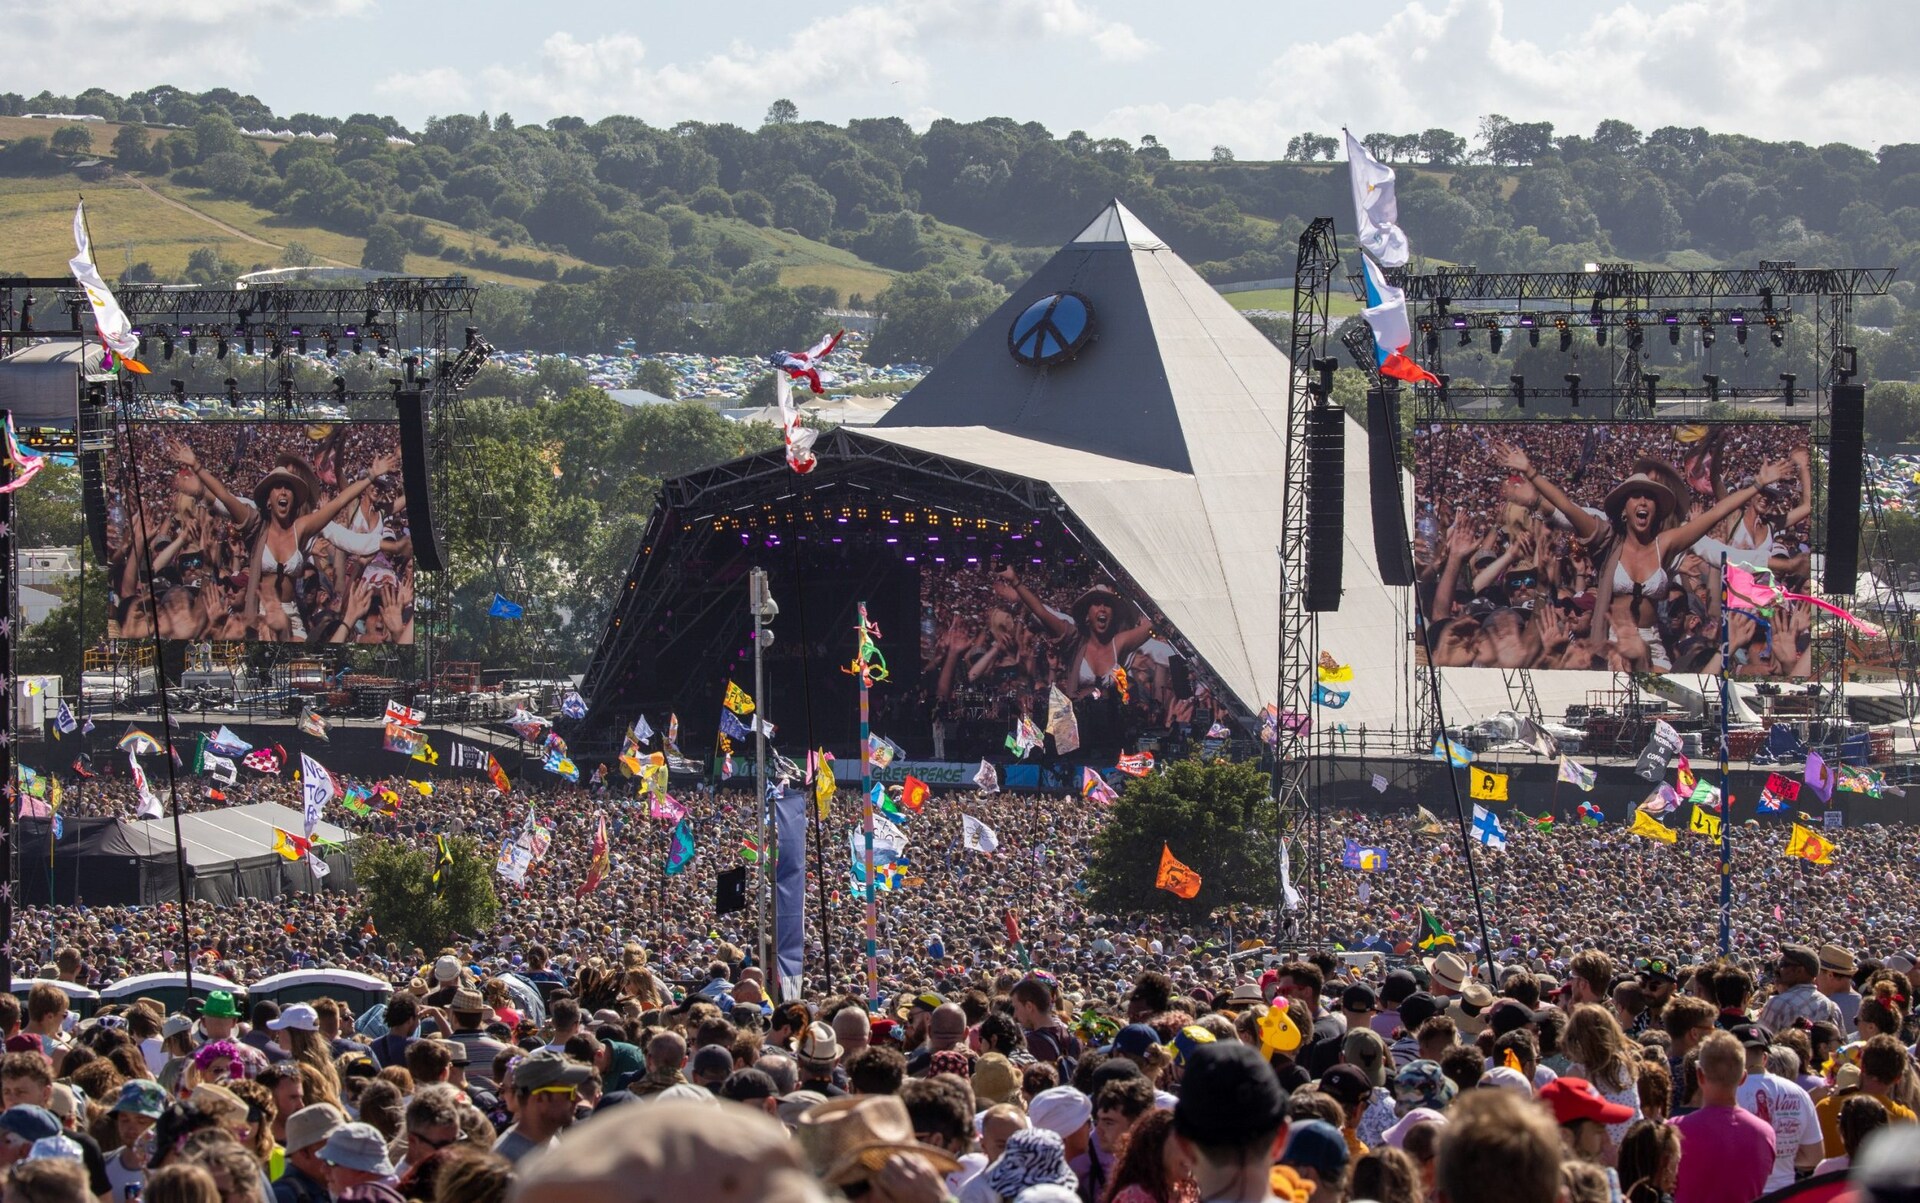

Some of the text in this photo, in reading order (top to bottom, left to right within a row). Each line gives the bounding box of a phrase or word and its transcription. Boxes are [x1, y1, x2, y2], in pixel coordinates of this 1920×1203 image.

[1653, 734, 1674, 751] MONDA
[1658, 746, 1666, 755] IS
[871, 767, 966, 782] GREENPEACE
[305, 784, 327, 804] TO
[1775, 1094, 1801, 1112] Vans
